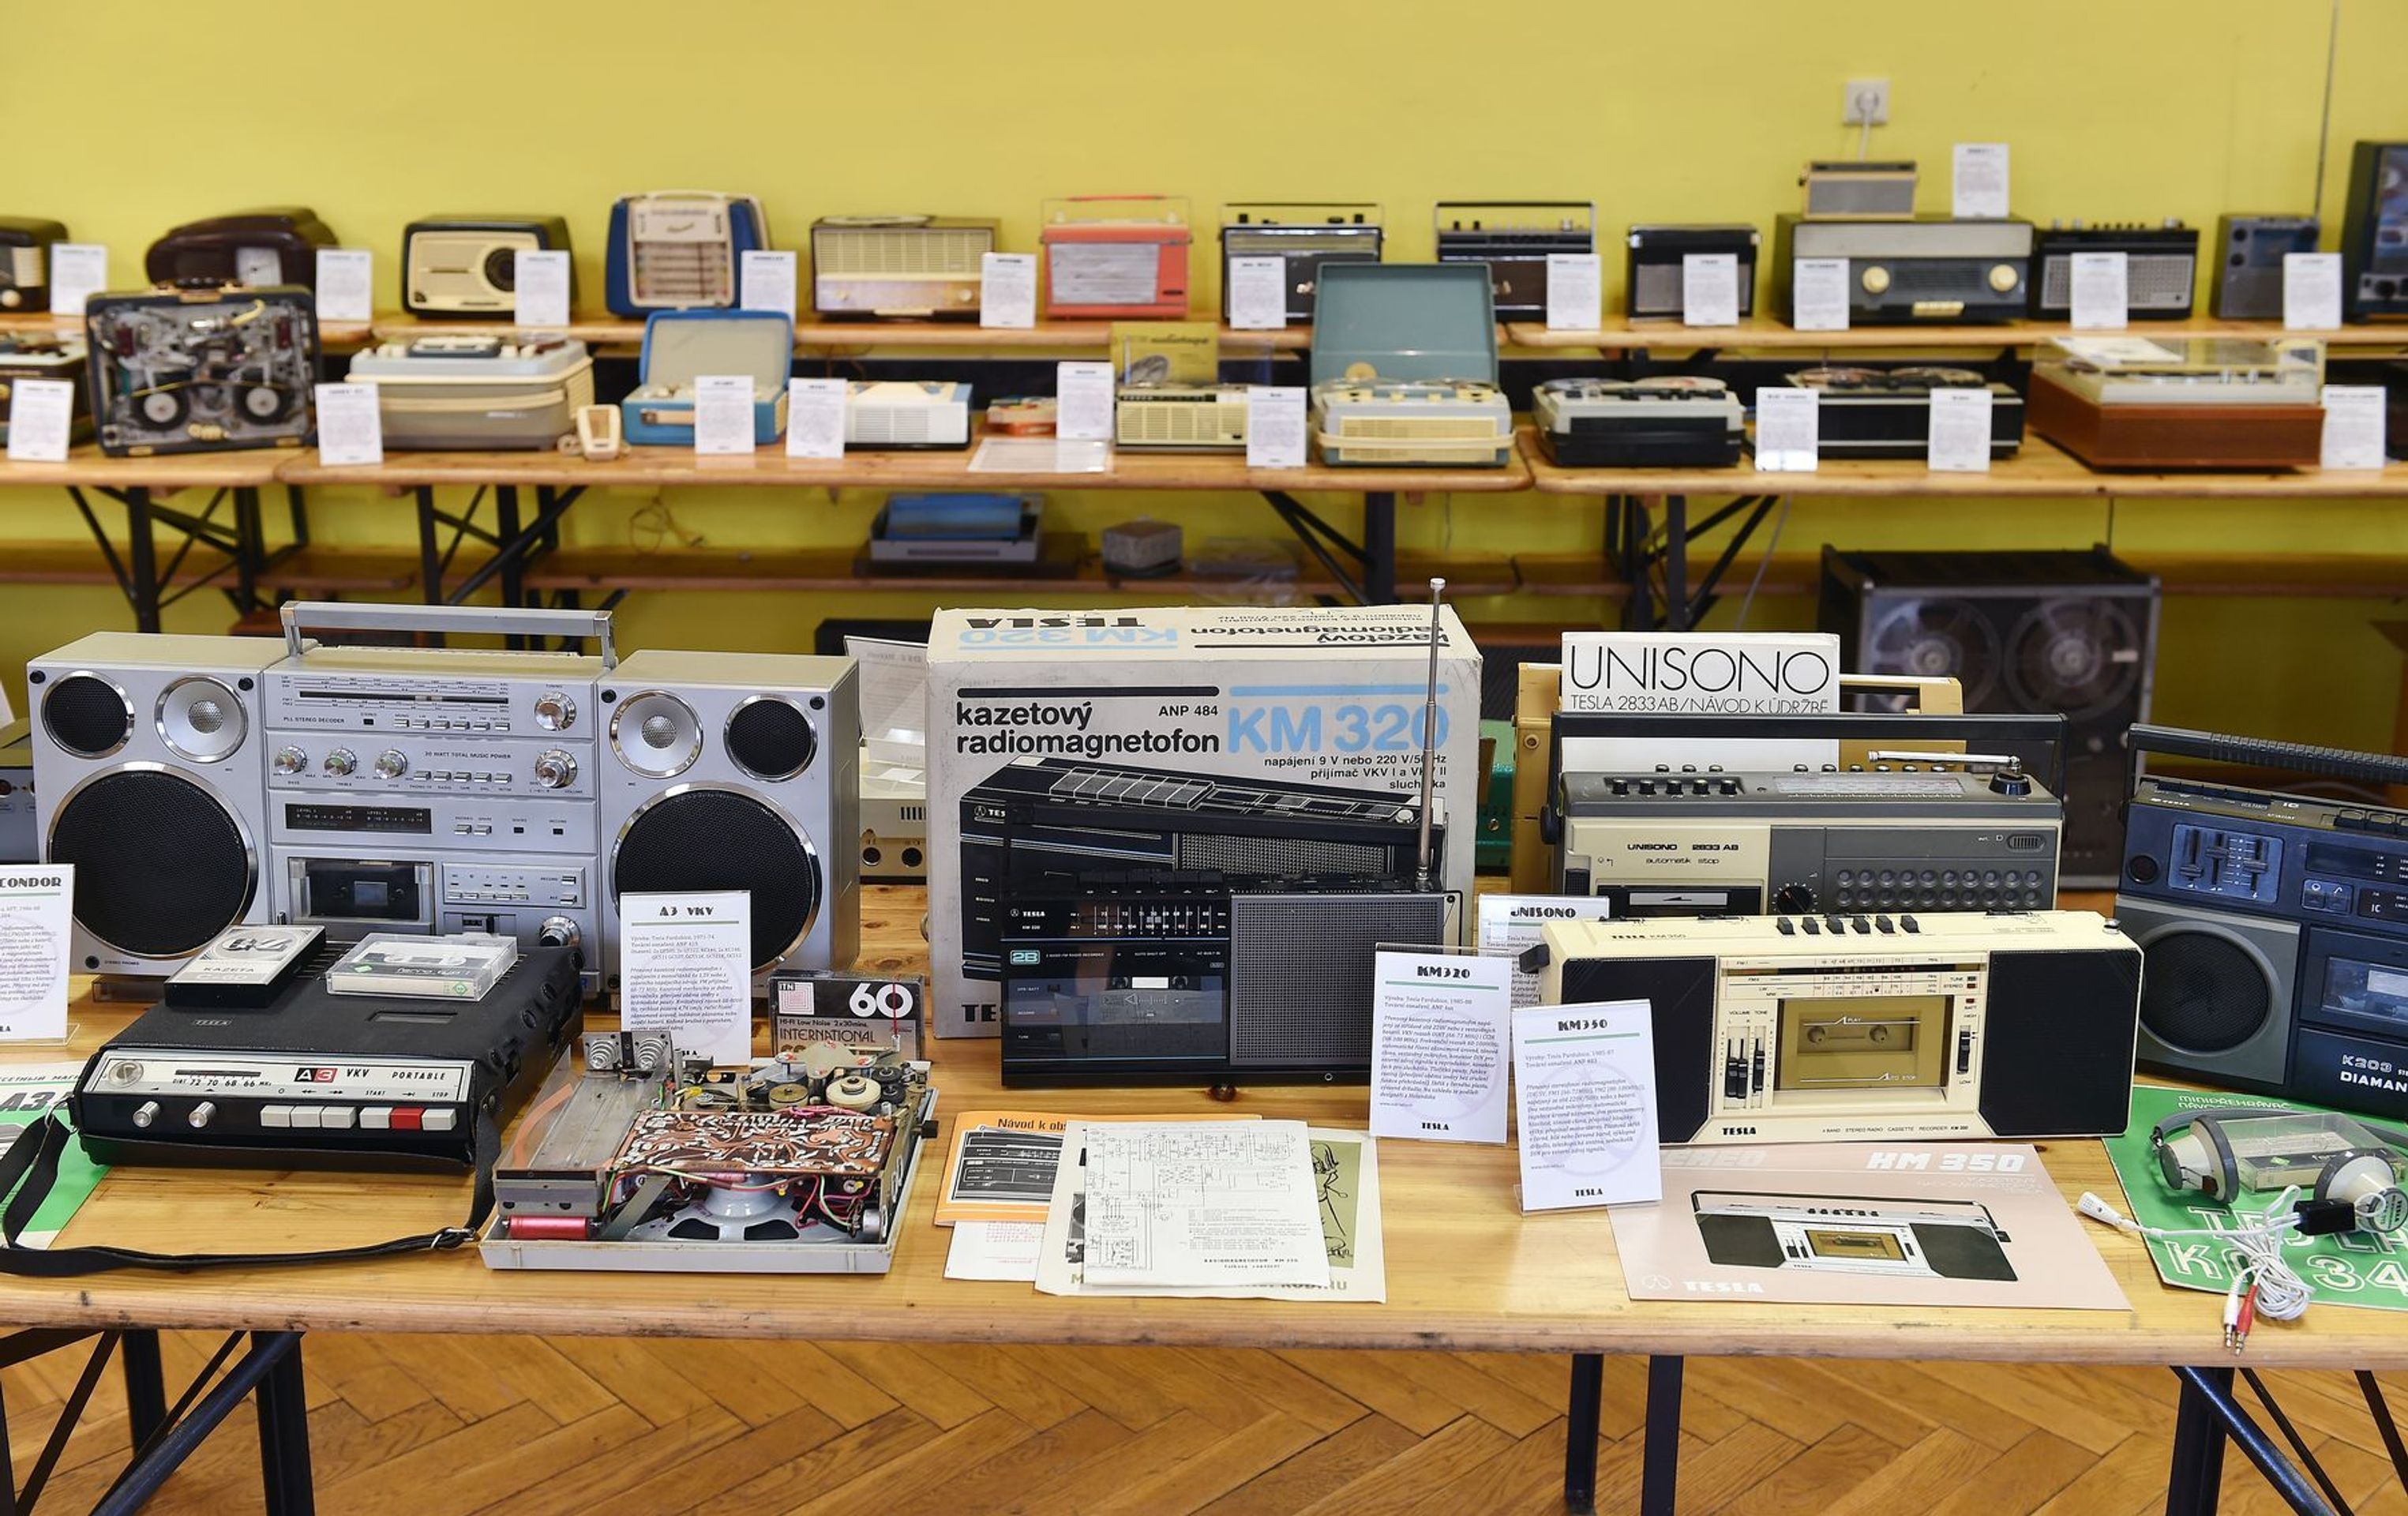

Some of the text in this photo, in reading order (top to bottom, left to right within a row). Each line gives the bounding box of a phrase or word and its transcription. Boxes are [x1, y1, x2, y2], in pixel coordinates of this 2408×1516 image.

[966, 617, 1146, 629] TESLA
[1571, 644, 1830, 695] UNISONO
[1158, 704, 1219, 717] ANP 484
[1570, 694, 1614, 711] TESLA
[1618, 695, 1656, 712] 2833
[1754, 699, 1765, 713] K
[956, 701, 1093, 731] kazetový
[1228, 704, 1450, 754] KM 320
[956, 728, 1220, 759] radiomagnetofon
[1264, 755, 1315, 767] napájení
[1318, 756, 1326, 765] 9
[1330, 756, 1340, 765] V
[1342, 755, 1372, 765] nebo
[1376, 755, 1397, 765] 220
[1311, 767, 1360, 780] přijímač
[1363, 767, 1388, 777] VKV
[659, 906, 715, 916] A3 VKV
[1416, 965, 1471, 979] KM320
[849, 981, 914, 1019] 60
[961, 1004, 1001, 1023] TE
[1558, 1019, 1608, 1032] KM350
[779, 1027, 876, 1044] INTERNATIONAL
[295, 1068, 446, 1083] A3 VKV PORTABLE
[2339, 1070, 2408, 1094] DIAMAN
[997, 1117, 1034, 1130] Návod
[1037, 1120, 1046, 1131] k
[1421, 1121, 1450, 1131] TESLA
[1722, 1127, 1757, 1135] TESLA
[1937, 1154, 2027, 1173] 350
[1574, 1188, 1603, 1198] TESLA
[1682, 1281, 1765, 1294] TESLA
